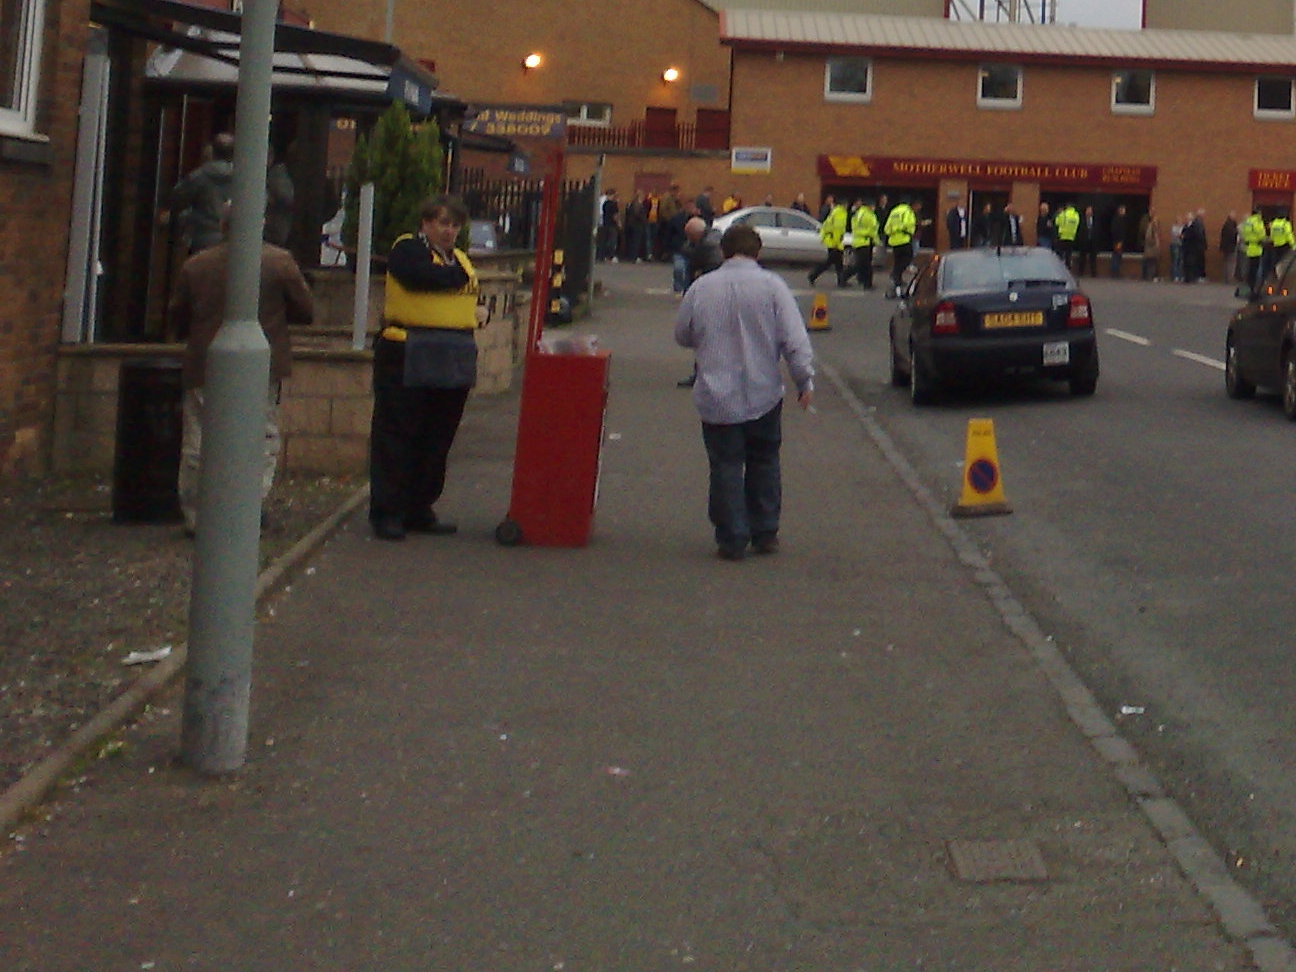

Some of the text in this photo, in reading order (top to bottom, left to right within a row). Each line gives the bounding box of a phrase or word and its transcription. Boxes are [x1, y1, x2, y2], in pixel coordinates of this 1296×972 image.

[495, 109, 561, 123] Weddings
[892, 161, 1089, 179] MOTHERWELL FOOTBALL CLUB
